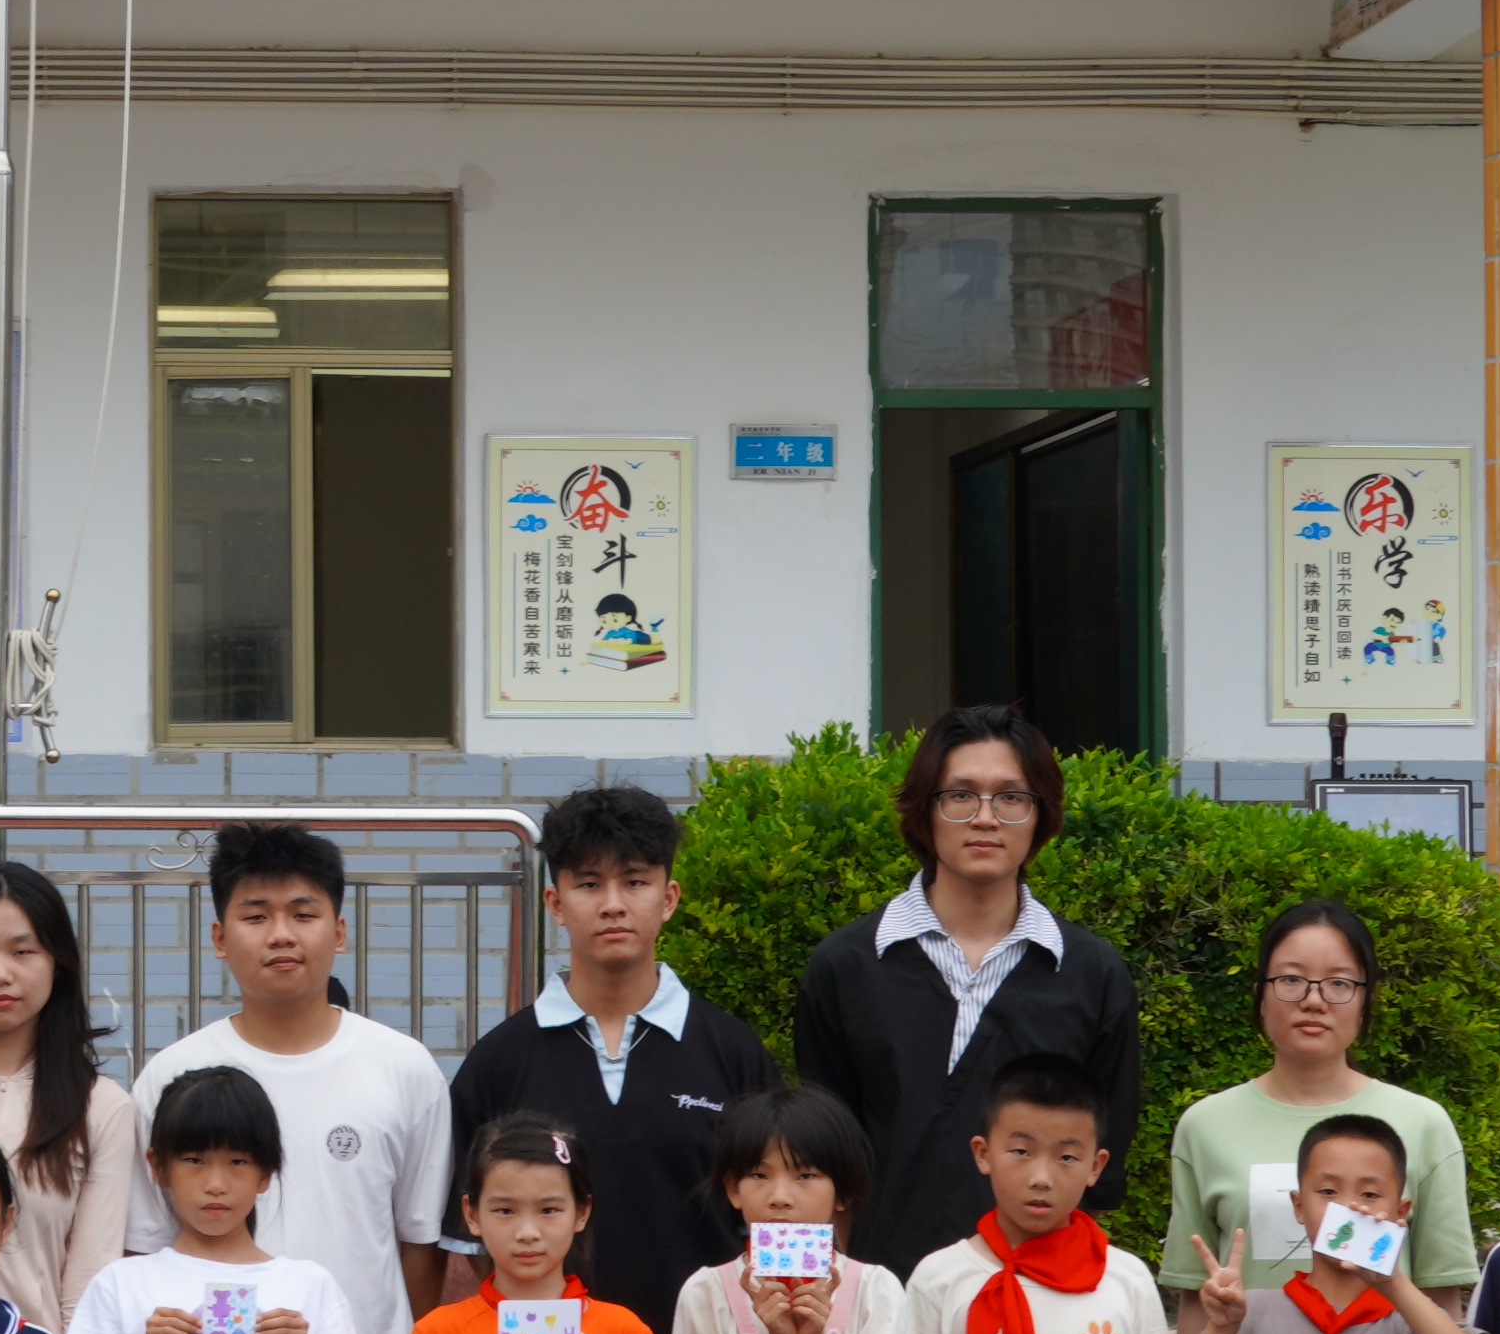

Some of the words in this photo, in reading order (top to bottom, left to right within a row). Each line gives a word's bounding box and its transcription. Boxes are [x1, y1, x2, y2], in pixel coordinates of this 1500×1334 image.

[745, 441, 825, 464] 二年级
[565, 464, 630, 533] 奋
[1358, 475, 1406, 534] 乐
[591, 533, 637, 589] 斗
[1374, 535, 1414, 590] 学
[523, 551, 542, 675] 梅花香自苦寒来
[555, 534, 574, 658] 宝剑锋从磨砺出
[1302, 563, 1321, 684] 熟读精思子自如
[1335, 551, 1353, 661] 旧书不厌百回读
